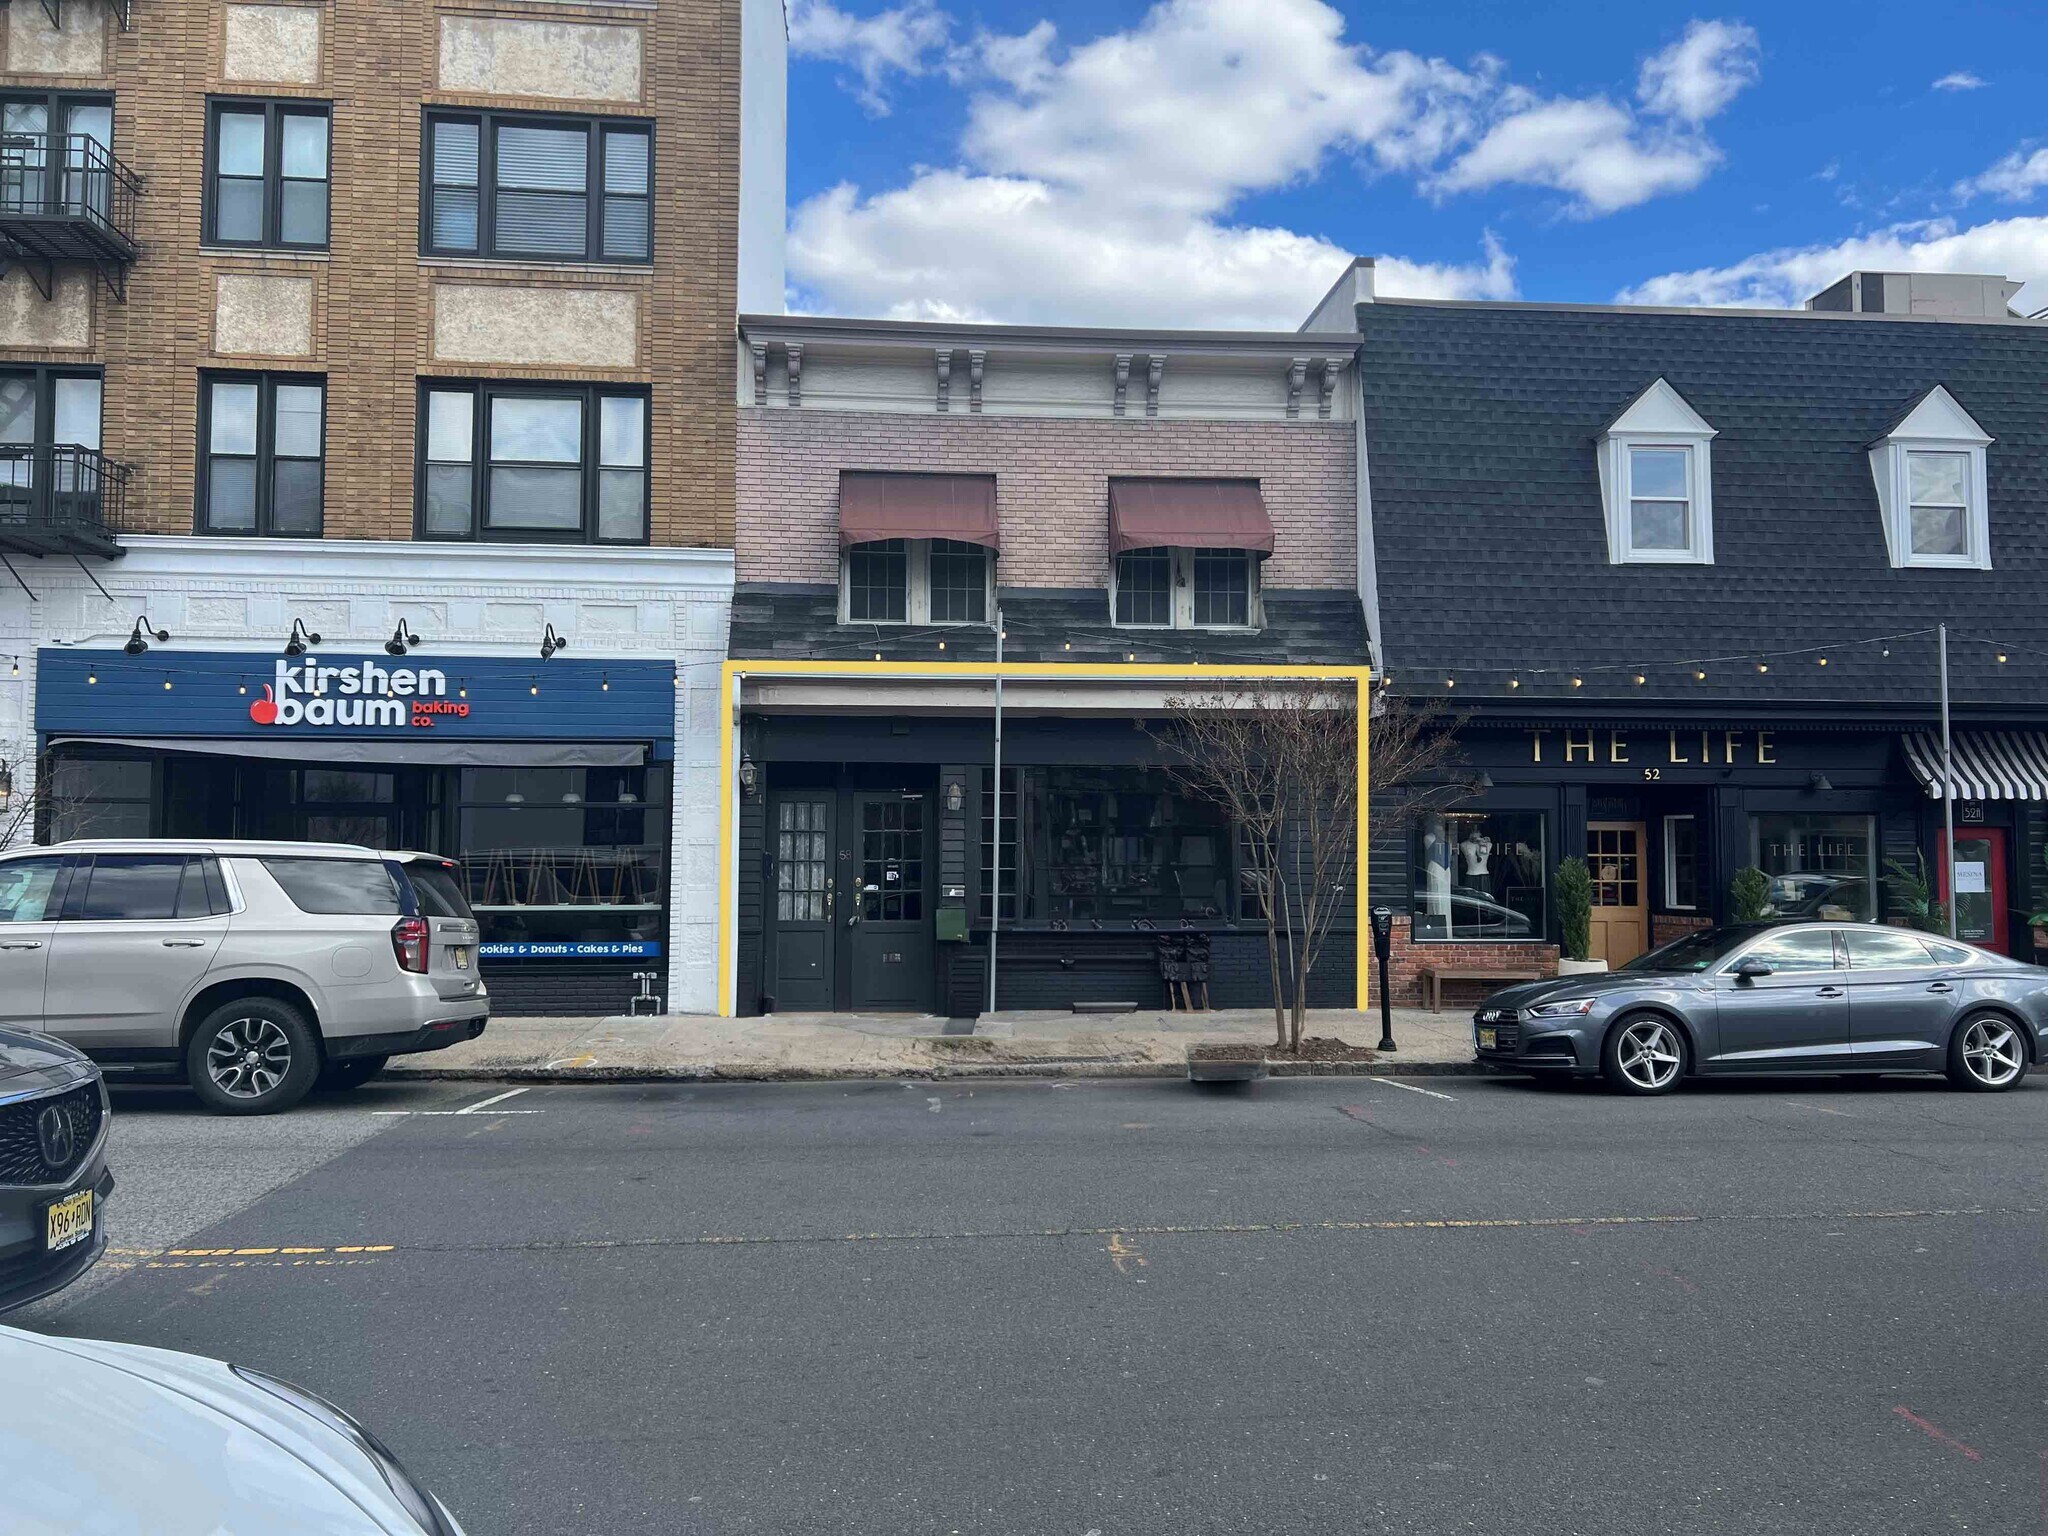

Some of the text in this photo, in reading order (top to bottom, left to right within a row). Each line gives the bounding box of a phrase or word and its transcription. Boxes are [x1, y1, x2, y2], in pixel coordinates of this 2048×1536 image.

[275, 657, 446, 695] kirshen
[274, 696, 407, 726] baum
[411, 701, 470, 717] baking
[411, 716, 434, 727] co.
[1524, 729, 1777, 764] THE LIFE
[1644, 768, 1660, 780] 52
[1770, 844, 1855, 857] THE LIFE
[479, 943, 643, 954] ookies & Donuts Cakes & Pies
